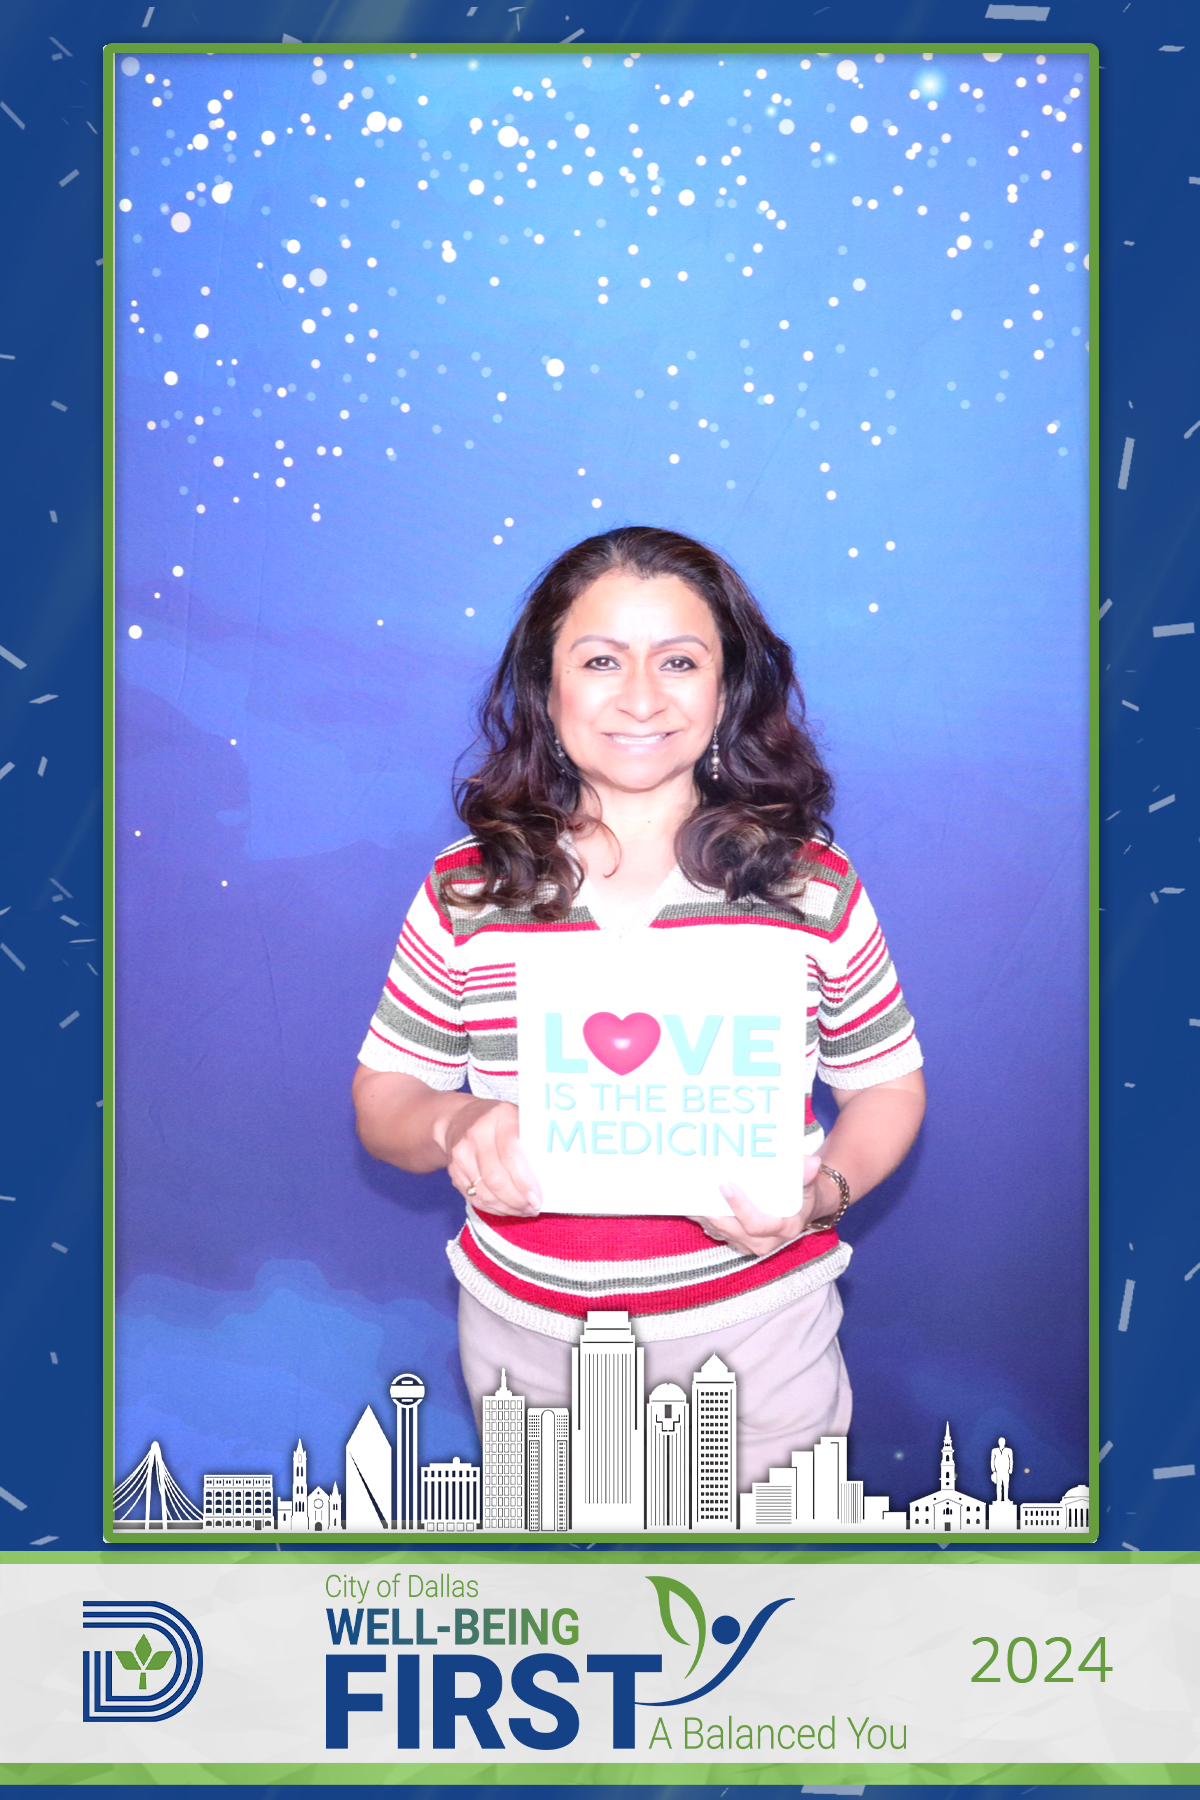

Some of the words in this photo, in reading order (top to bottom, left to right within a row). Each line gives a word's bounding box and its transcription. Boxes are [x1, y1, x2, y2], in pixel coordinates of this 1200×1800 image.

[545, 1082, 576, 1111] IS
[590, 1083, 667, 1112] THE
[682, 1084, 780, 1114] BEST
[546, 1119, 777, 1158] MEDICINE
